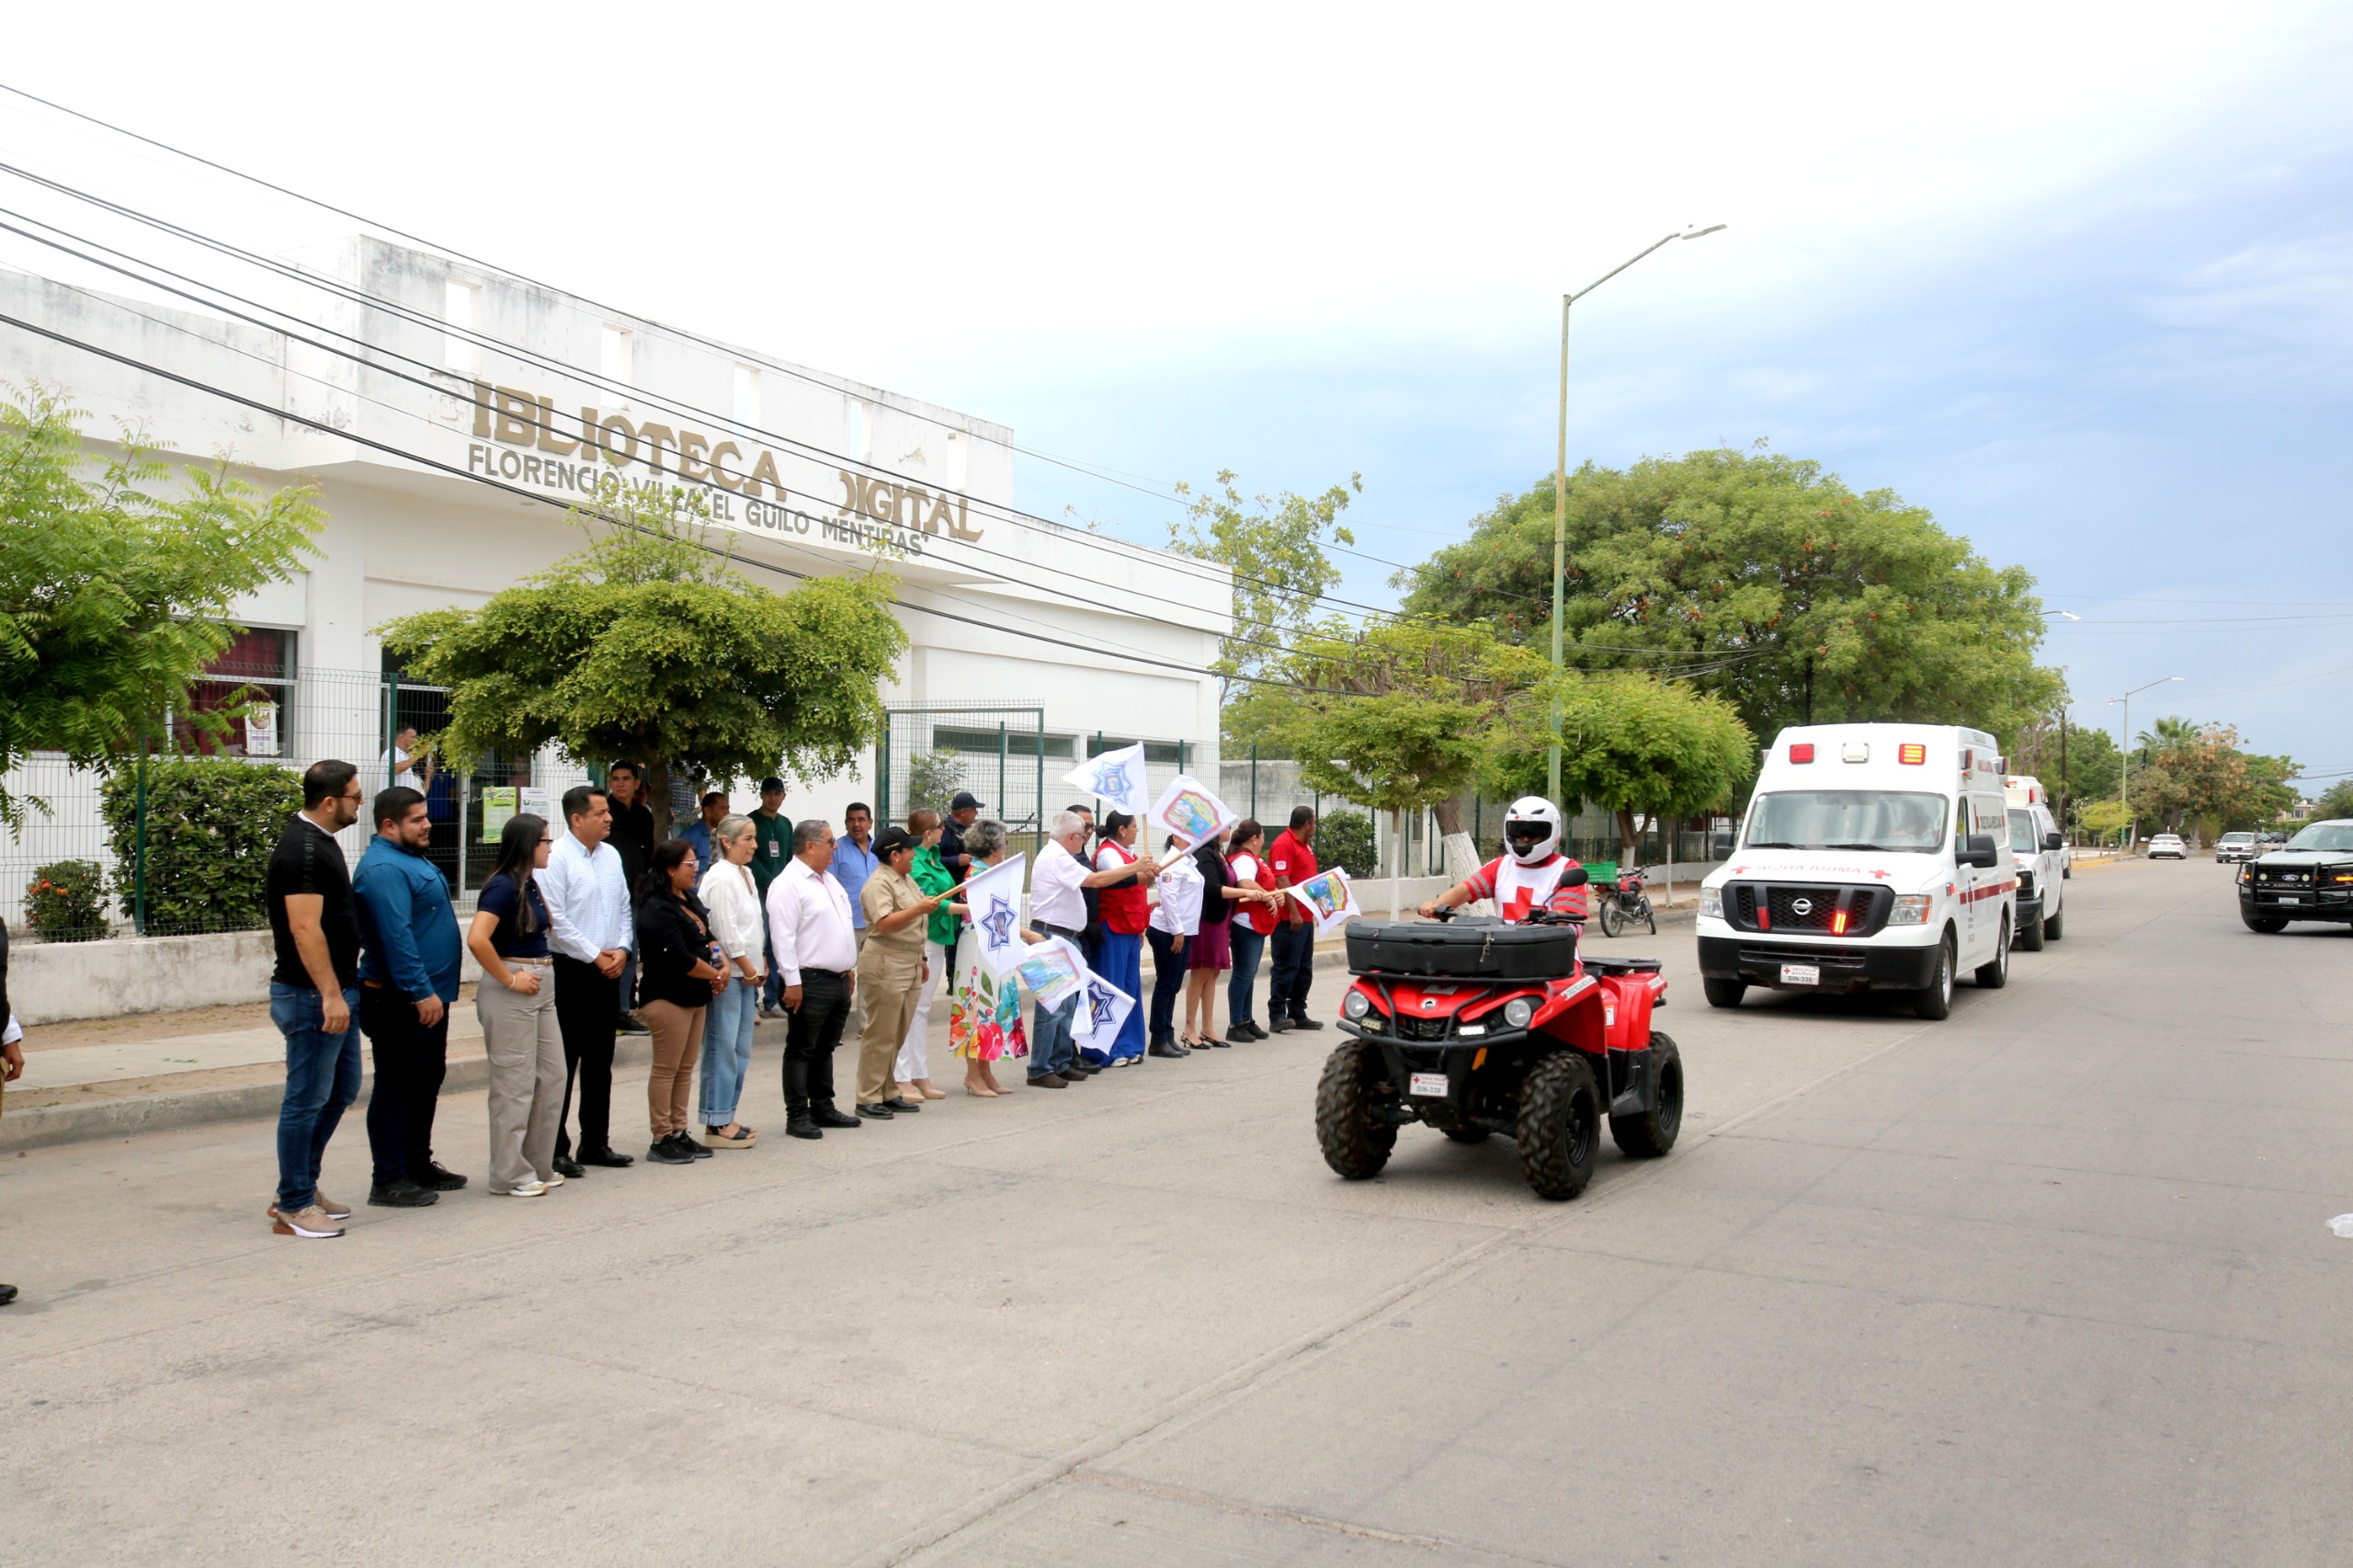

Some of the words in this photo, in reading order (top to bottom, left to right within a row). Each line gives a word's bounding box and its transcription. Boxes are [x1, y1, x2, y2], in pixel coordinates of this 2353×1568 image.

[469, 443, 620, 497] FLORENCIO
[745, 500, 810, 535] GÜILO
[472, 378, 787, 502] IBLIOTECA
